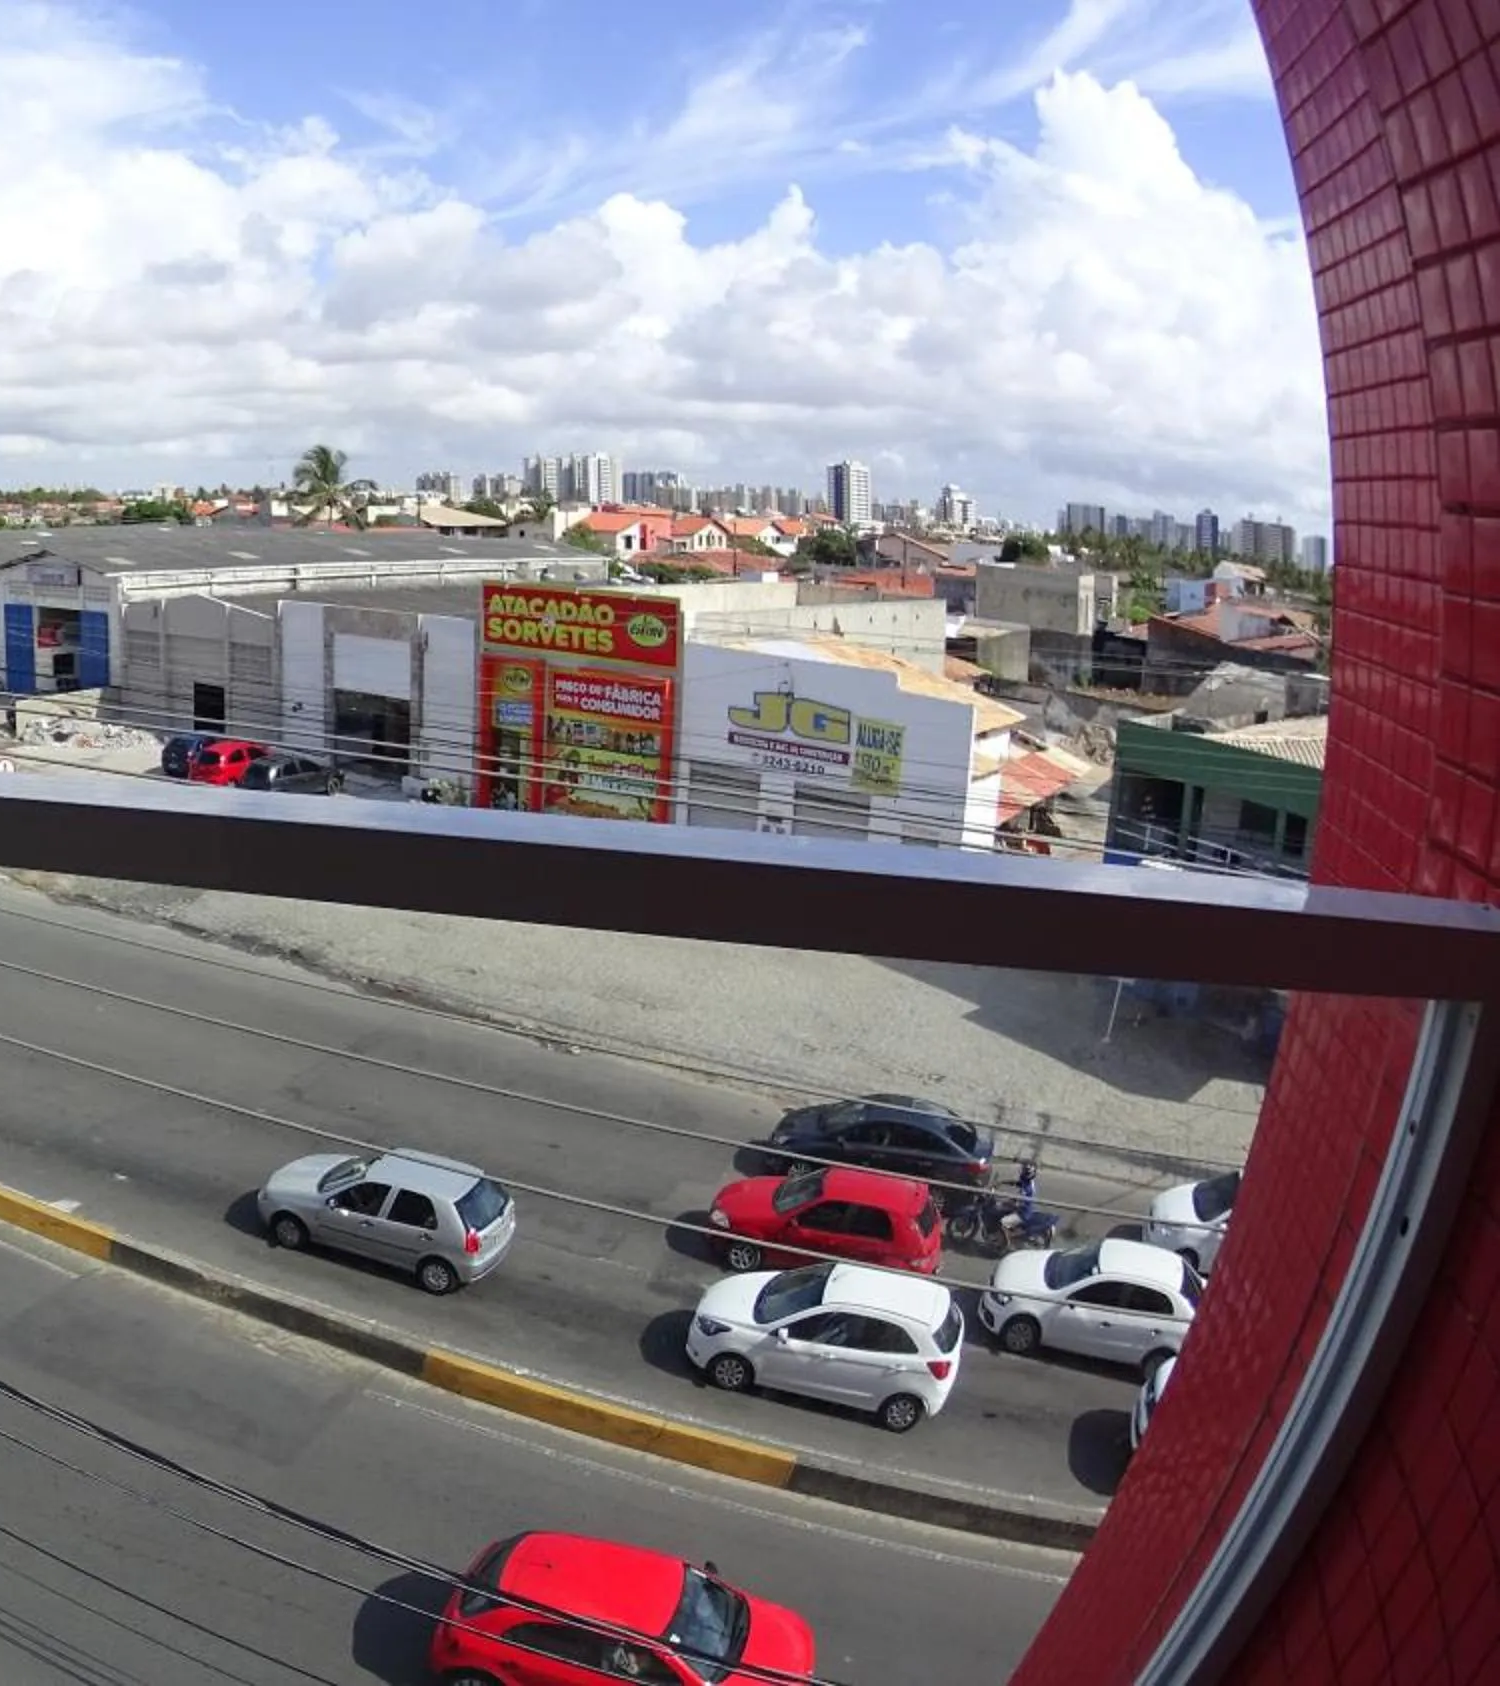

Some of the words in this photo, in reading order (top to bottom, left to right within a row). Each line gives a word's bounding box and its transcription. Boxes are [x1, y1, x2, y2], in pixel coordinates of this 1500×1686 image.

[489, 594, 615, 626] ATACADÃO
[488, 617, 613, 653] SORVETES
[580, 697, 661, 721] CONSUMIDOR
[605, 683, 662, 707] FÁBRICA
